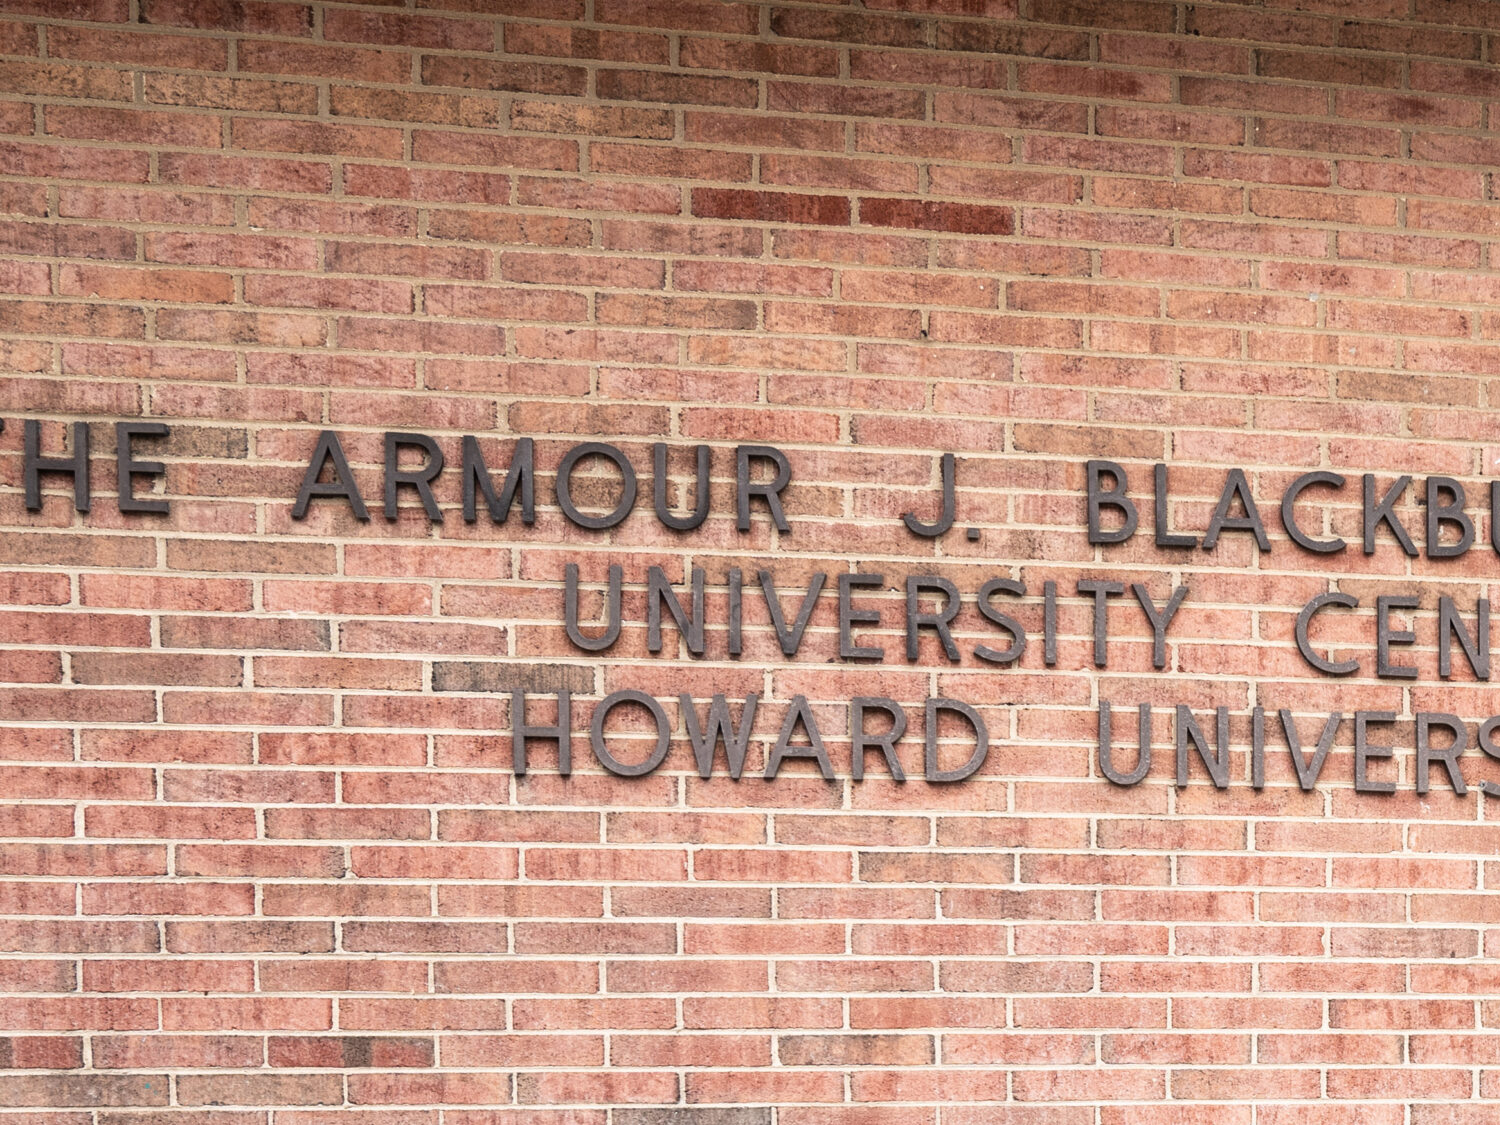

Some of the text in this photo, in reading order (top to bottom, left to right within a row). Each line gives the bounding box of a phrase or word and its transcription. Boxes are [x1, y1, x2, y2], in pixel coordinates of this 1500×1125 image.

[0, 417, 171, 514] HE
[292, 430, 792, 533] ARMOUR
[904, 452, 981, 540] J.
[565, 563, 1189, 669] UNIVERSITY
[511, 687, 989, 784] HOWARD
